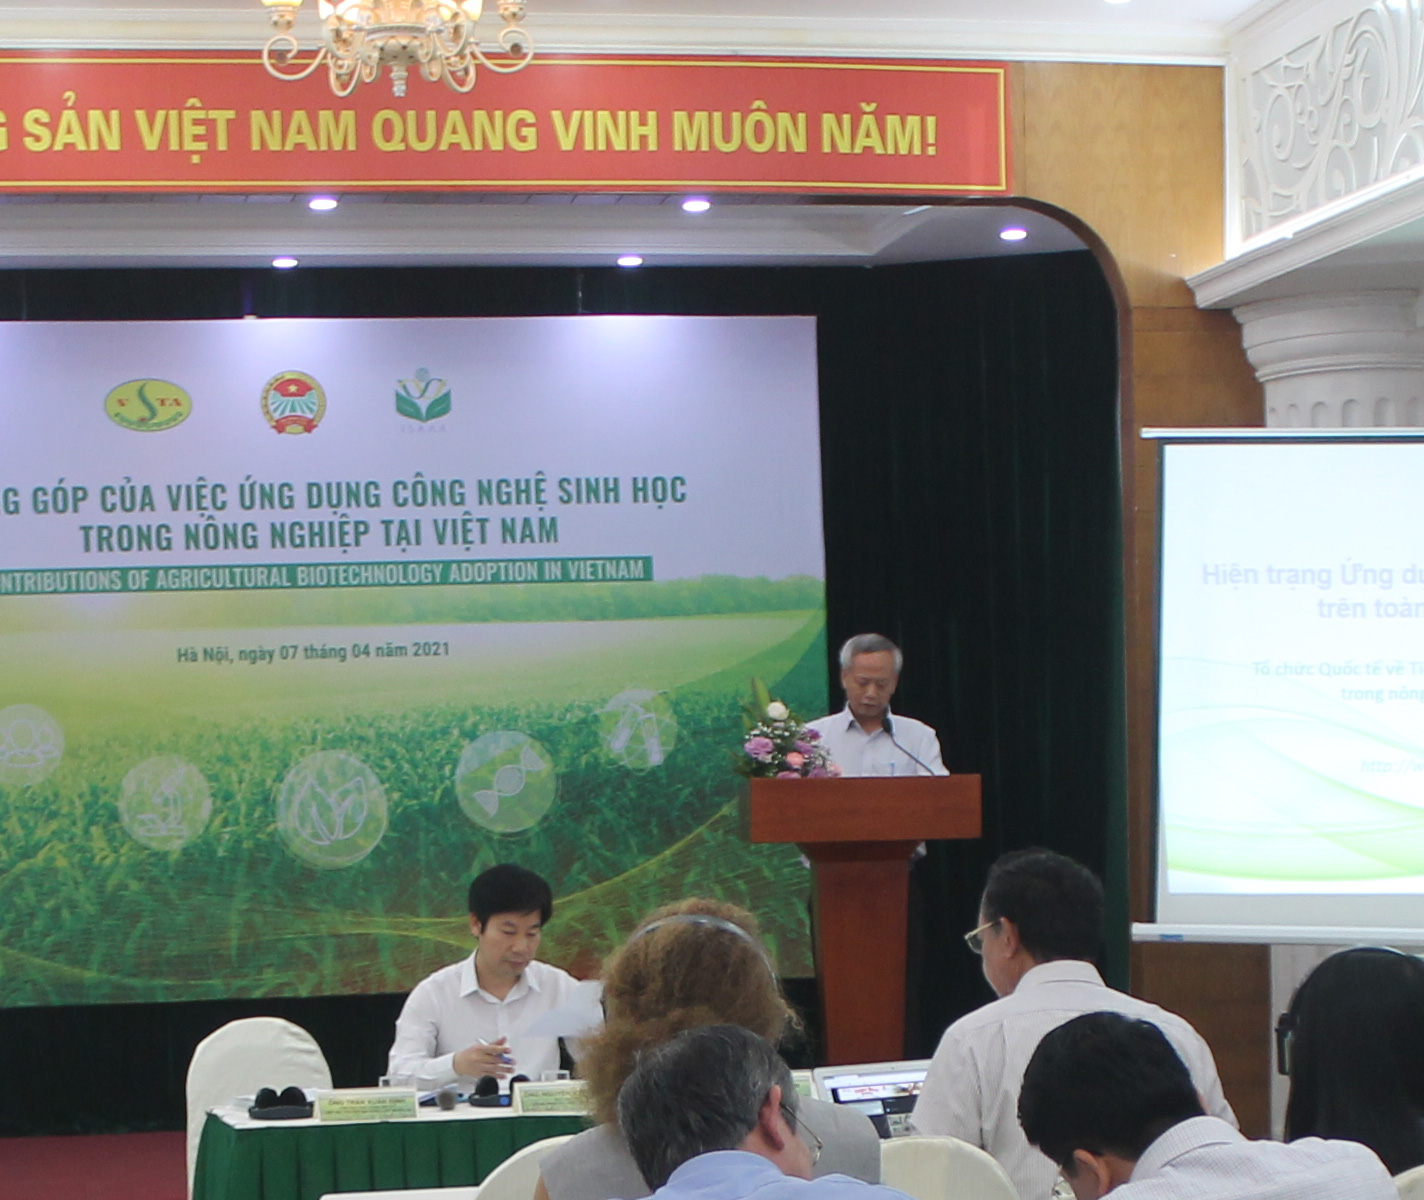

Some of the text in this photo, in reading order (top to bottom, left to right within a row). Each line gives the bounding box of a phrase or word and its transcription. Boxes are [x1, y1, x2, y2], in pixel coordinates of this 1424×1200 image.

[23, 91, 120, 152] SẢN
[135, 98, 236, 163] VIỆT
[251, 110, 357, 151] NAM
[372, 110, 538, 152] QUANG
[552, 110, 658, 151] VINH
[673, 101, 807, 153] MUÔN
[822, 102, 937, 156] NĂM!
[32, 478, 89, 515] GÓP
[100, 476, 156, 513] CỦA
[167, 476, 227, 519] VIỆC
[239, 475, 295, 511] ỨNG
[306, 480, 381, 516] DỤNG
[392, 471, 466, 507] CÔNG
[477, 470, 548, 511] NGHỆ
[558, 476, 620, 505] SINH
[632, 475, 688, 509] HỌC
[80, 511, 559, 554] TRONG NÔNG NGHIỆP TẠI VIỆT NAM
[128, 570, 151, 590] OF
[156, 566, 291, 590] AGRICULTURAL
[297, 562, 444, 587] BIOTECHNOLOGY
[449, 561, 539, 583] ADOPTION
[543, 560, 563, 581] IN
[567, 558, 645, 581] VIETNAM
[1202, 562, 1259, 591] Hiện
[1267, 563, 1333, 591] trạng
[1340, 556, 1394, 590] Ứng
[1317, 597, 1367, 618] trên
[178, 641, 449, 665] Hà Nội, ngày 07 tháng 04 năm 2021
[1341, 688, 1384, 703] trong
